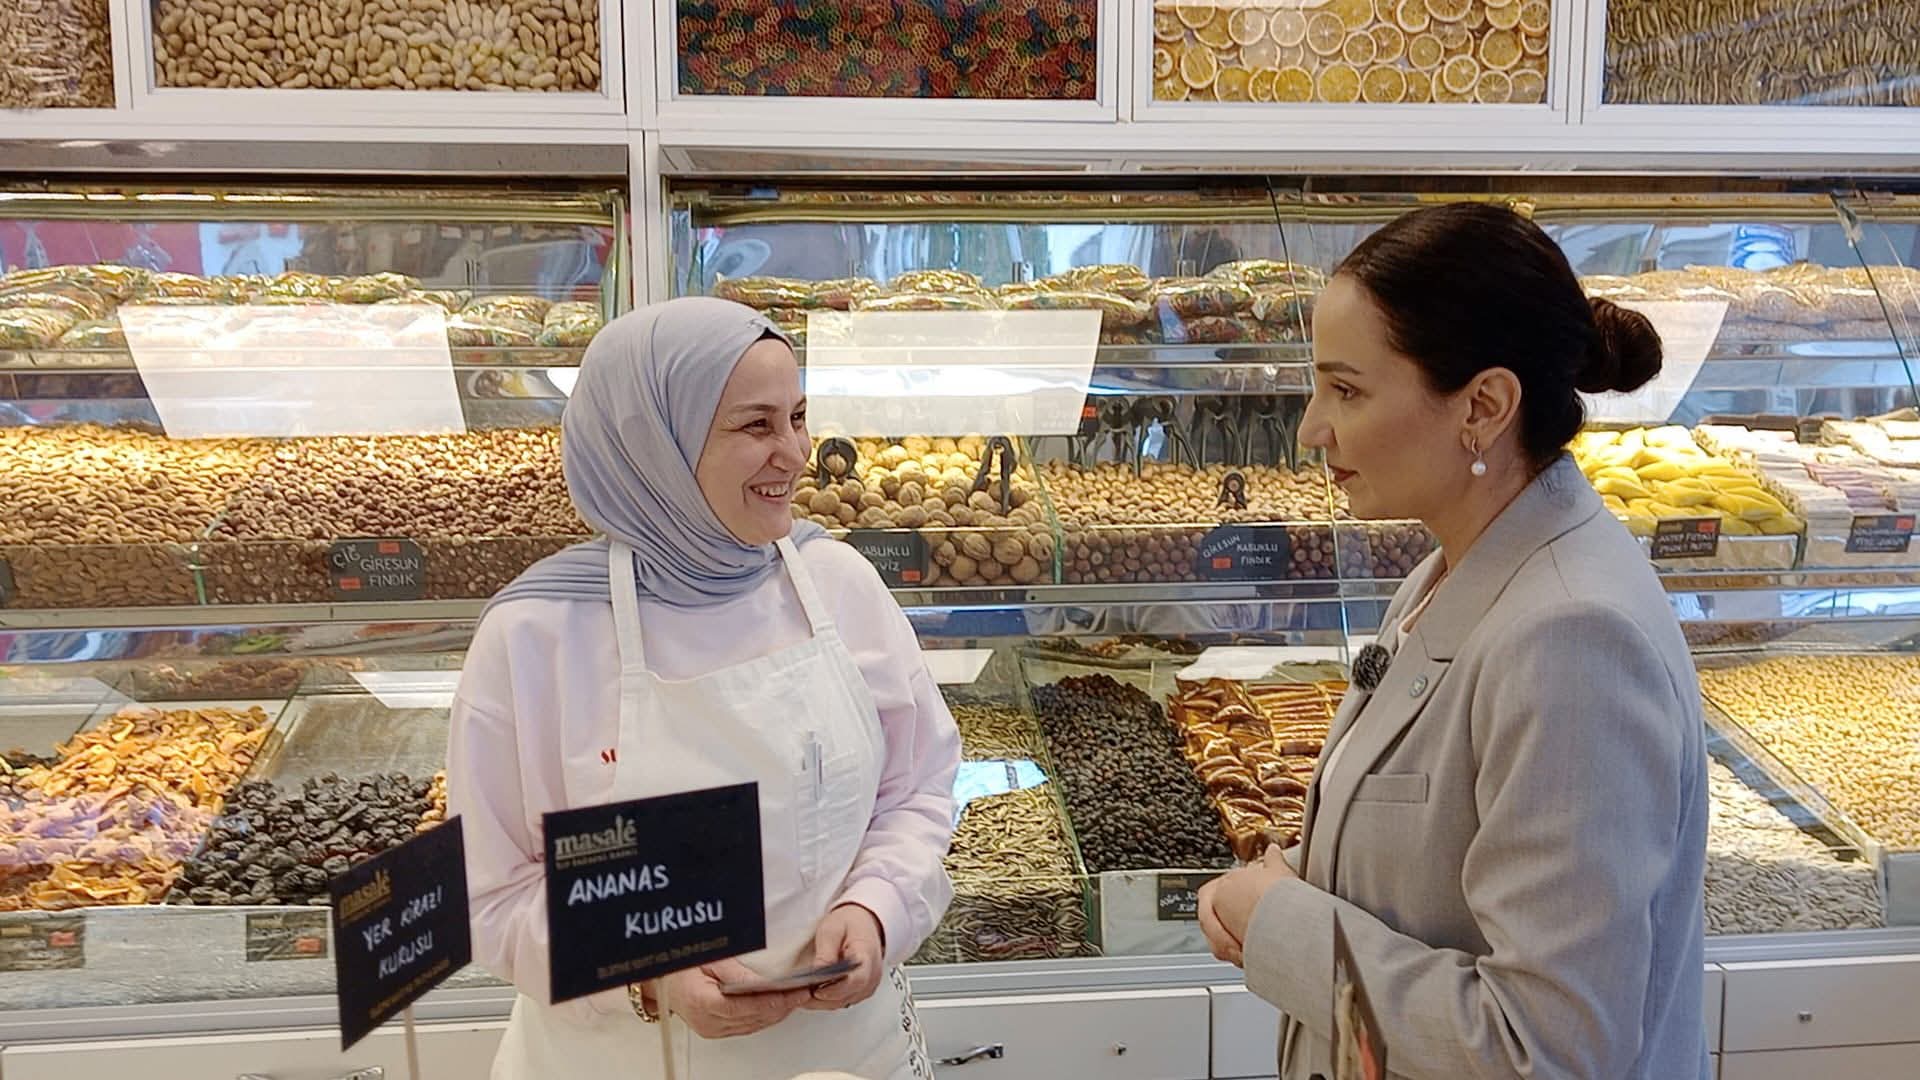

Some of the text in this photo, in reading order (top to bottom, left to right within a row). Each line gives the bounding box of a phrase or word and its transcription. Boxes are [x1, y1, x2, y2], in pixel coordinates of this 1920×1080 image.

[360, 554, 419, 571] GİRESUN
[369, 573, 417, 587] FINDIK
[555, 814, 638, 854] masalé
[568, 864, 670, 906] ANANAS
[362, 917, 393, 952] YER
[624, 900, 724, 939] KURUSU
[377, 930, 434, 979] KURUSU
